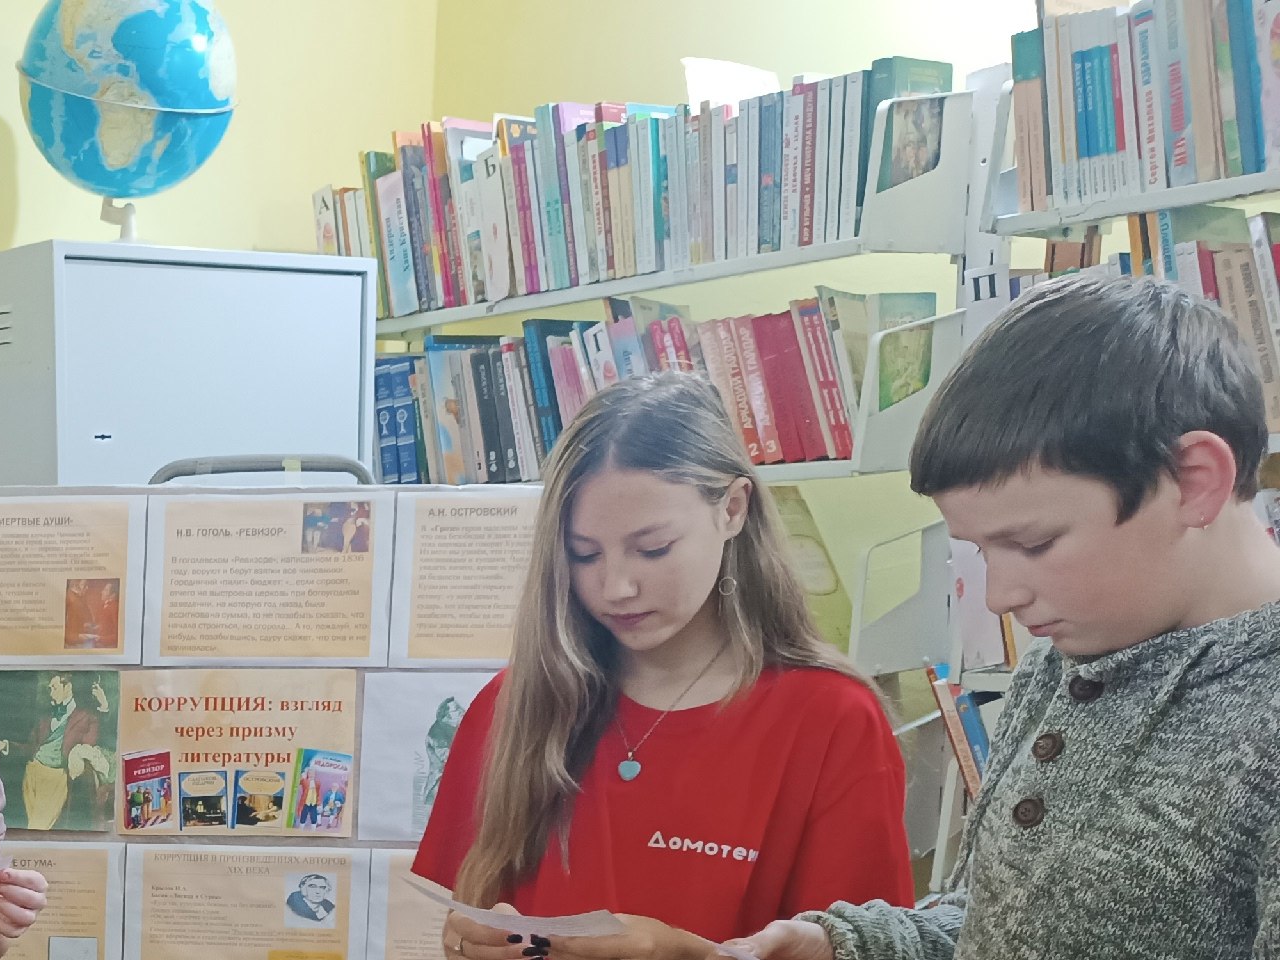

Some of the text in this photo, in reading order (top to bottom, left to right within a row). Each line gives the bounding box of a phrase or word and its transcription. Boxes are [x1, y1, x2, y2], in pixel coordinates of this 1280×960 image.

[484, 154, 497, 179] Б
[318, 194, 330, 214] А
[749, 443, 759, 457] 2
[766, 440, 777, 453] 3
[450, 506, 518, 517] ОСТРОВСКИЙ
[133, 696, 343, 714] КОРРУПЦИЯ: взгляд
[174, 725, 298, 741] через призму
[178, 751, 292, 767] литературы
[133, 764, 165, 777] РЕВИЗОР
[21, 859, 31, 867] ОТ
[303, 856, 346, 865] АВТОРОВ
